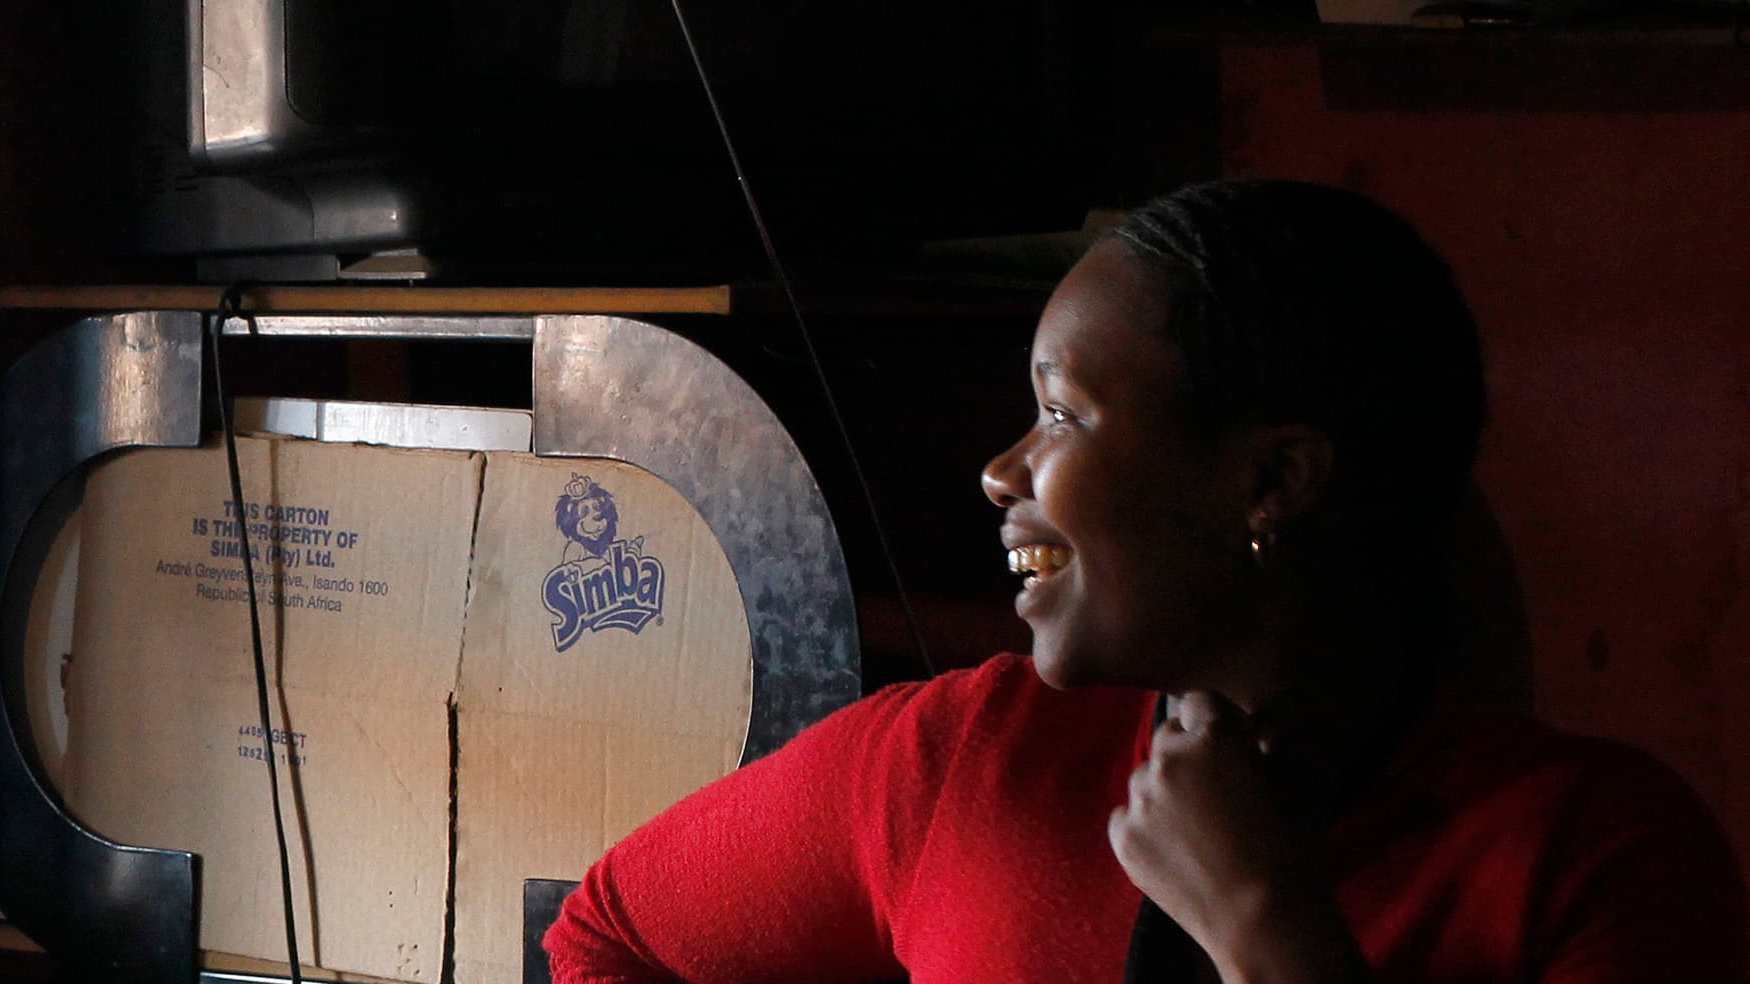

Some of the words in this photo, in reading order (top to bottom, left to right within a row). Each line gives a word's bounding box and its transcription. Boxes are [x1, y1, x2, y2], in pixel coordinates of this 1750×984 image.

[224, 500, 259, 520] TIS
[264, 503, 330, 527] CARTON
[193, 518, 208, 536] IS
[249, 524, 332, 547] PROPERTY
[337, 532, 358, 549] OF
[306, 550, 336, 568] Ltd.
[196, 583, 250, 602] Republic
[268, 590, 304, 609] Suth
[307, 595, 342, 612] Africa
[313, 575, 355, 593] Isando
[359, 579, 389, 596] 1600
[542, 540, 665, 652] Simba
